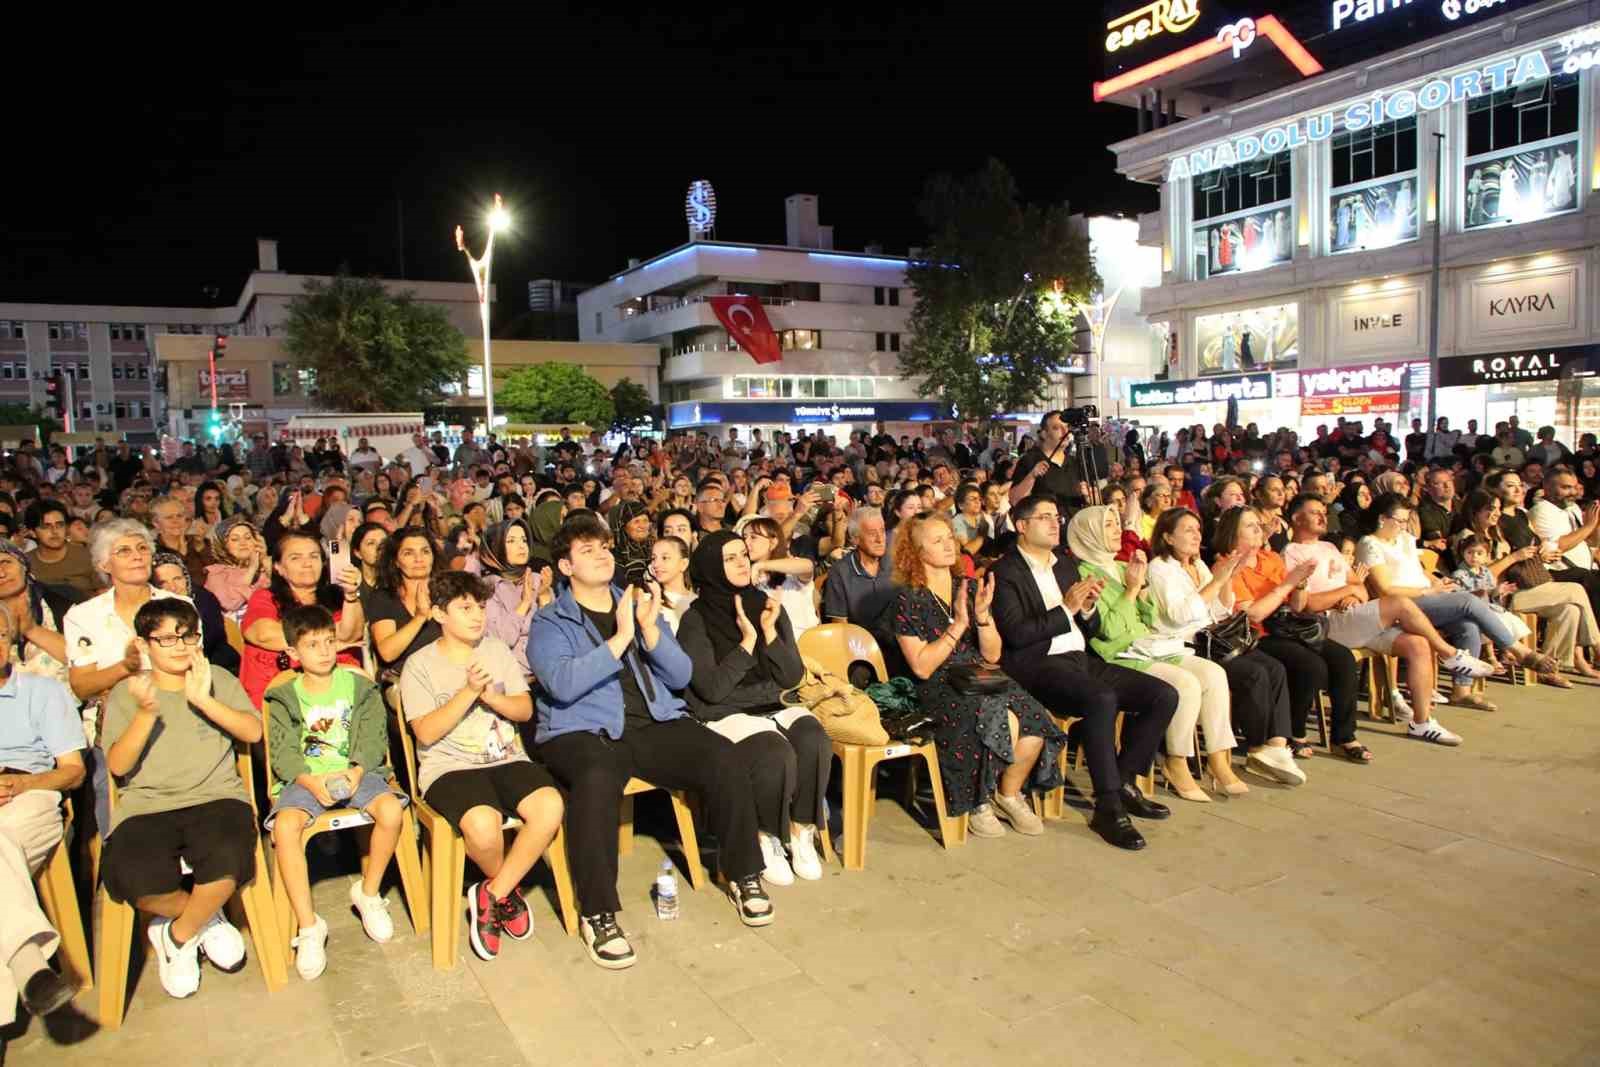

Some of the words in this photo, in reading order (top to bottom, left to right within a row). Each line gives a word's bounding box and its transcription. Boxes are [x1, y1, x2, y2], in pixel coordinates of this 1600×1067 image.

[1166, 112, 1334, 183] ANADOLU
[1344, 50, 1550, 131] SİGORTA
[1489, 293, 1555, 316] KAYRA
[1473, 353, 1560, 373] ROYAL
